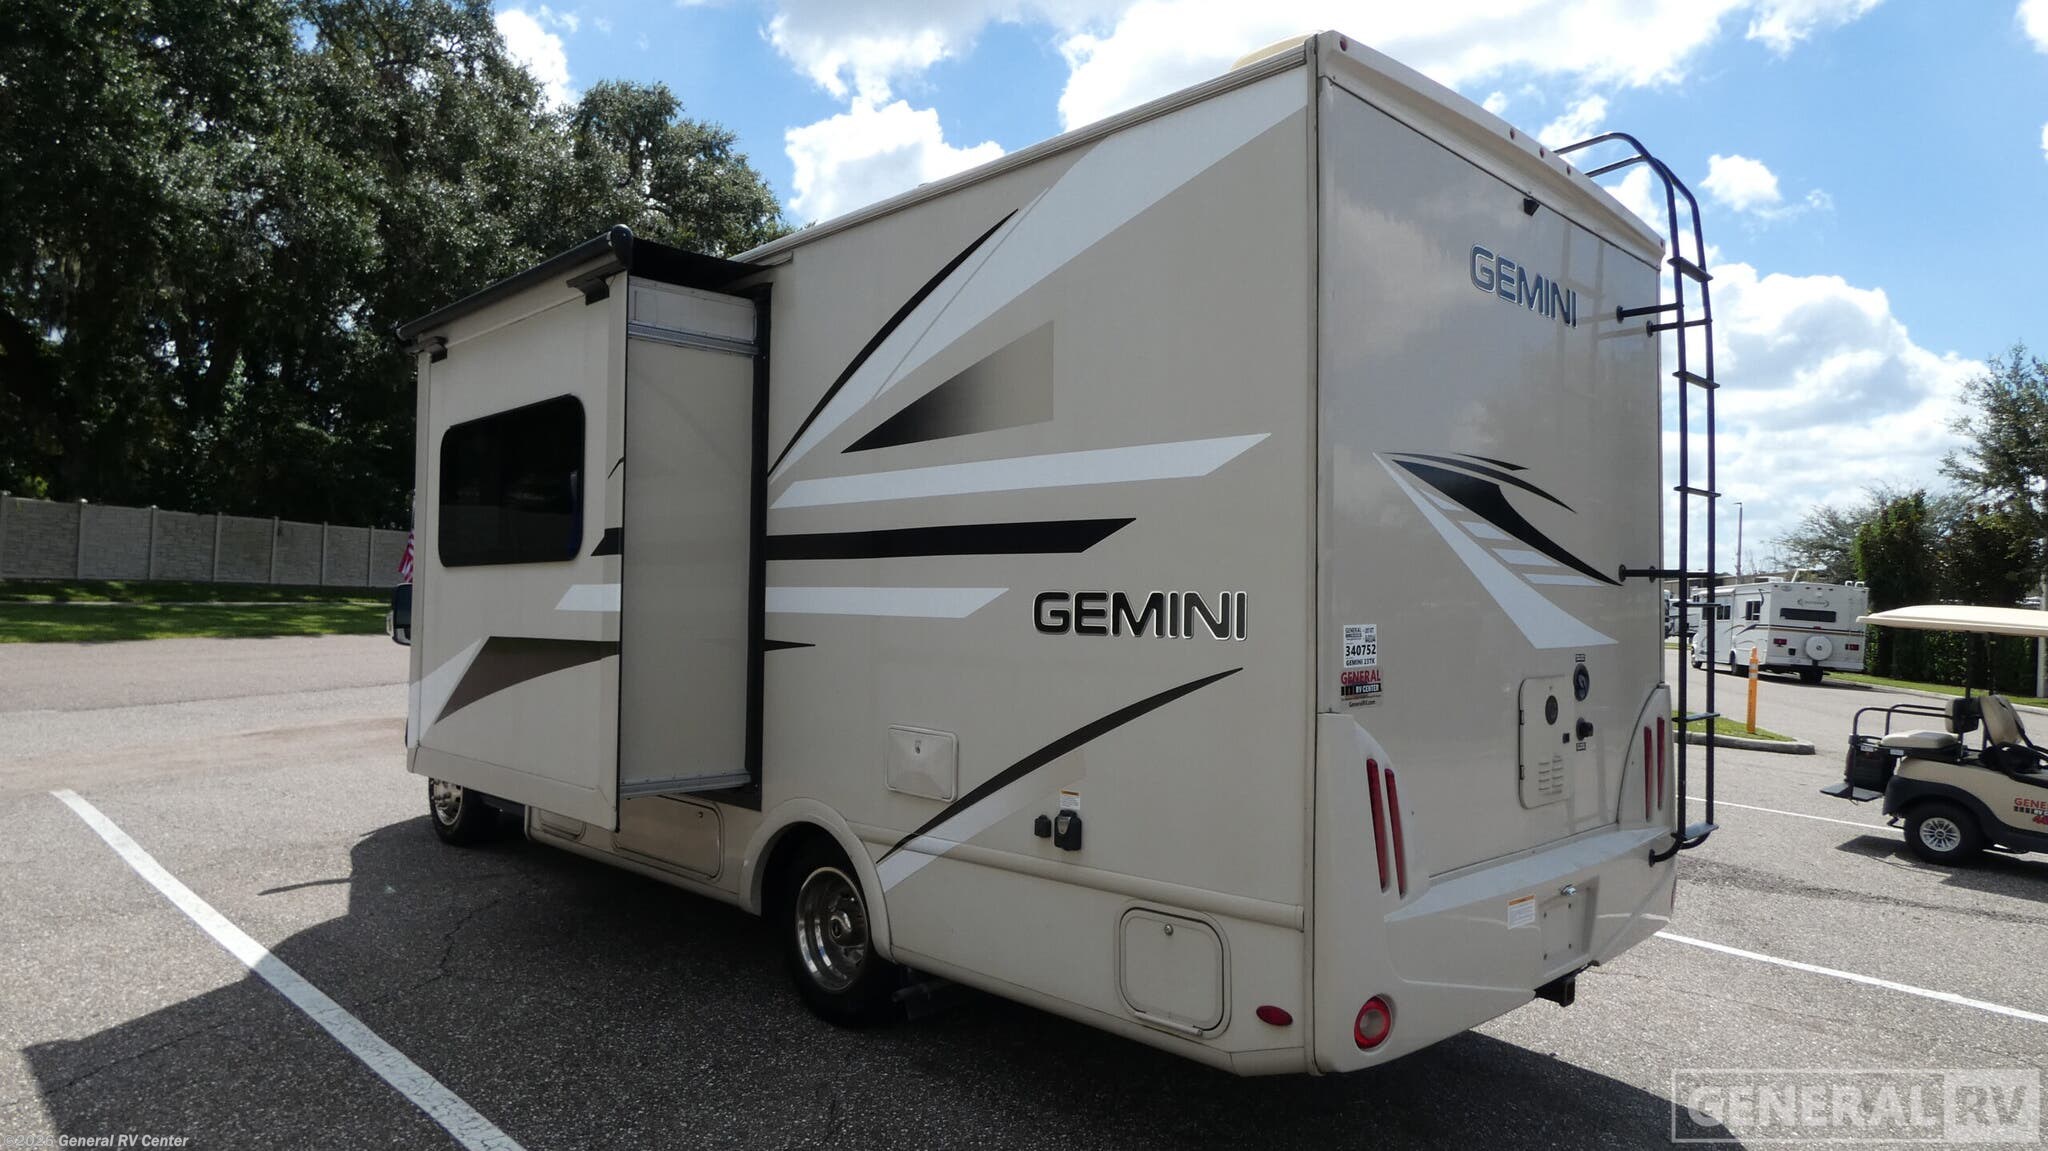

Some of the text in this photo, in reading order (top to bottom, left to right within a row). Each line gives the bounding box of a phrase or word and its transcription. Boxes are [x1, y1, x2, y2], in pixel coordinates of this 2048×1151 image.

[1470, 244, 1577, 329] GEMINI
[1033, 590, 1248, 641] GEMINI
[1345, 644, 1376, 657] 340752
[1341, 669, 1381, 685] GENERAL
[1355, 684, 1379, 693] RV CENTER
[2014, 797, 2048, 810] GENE
